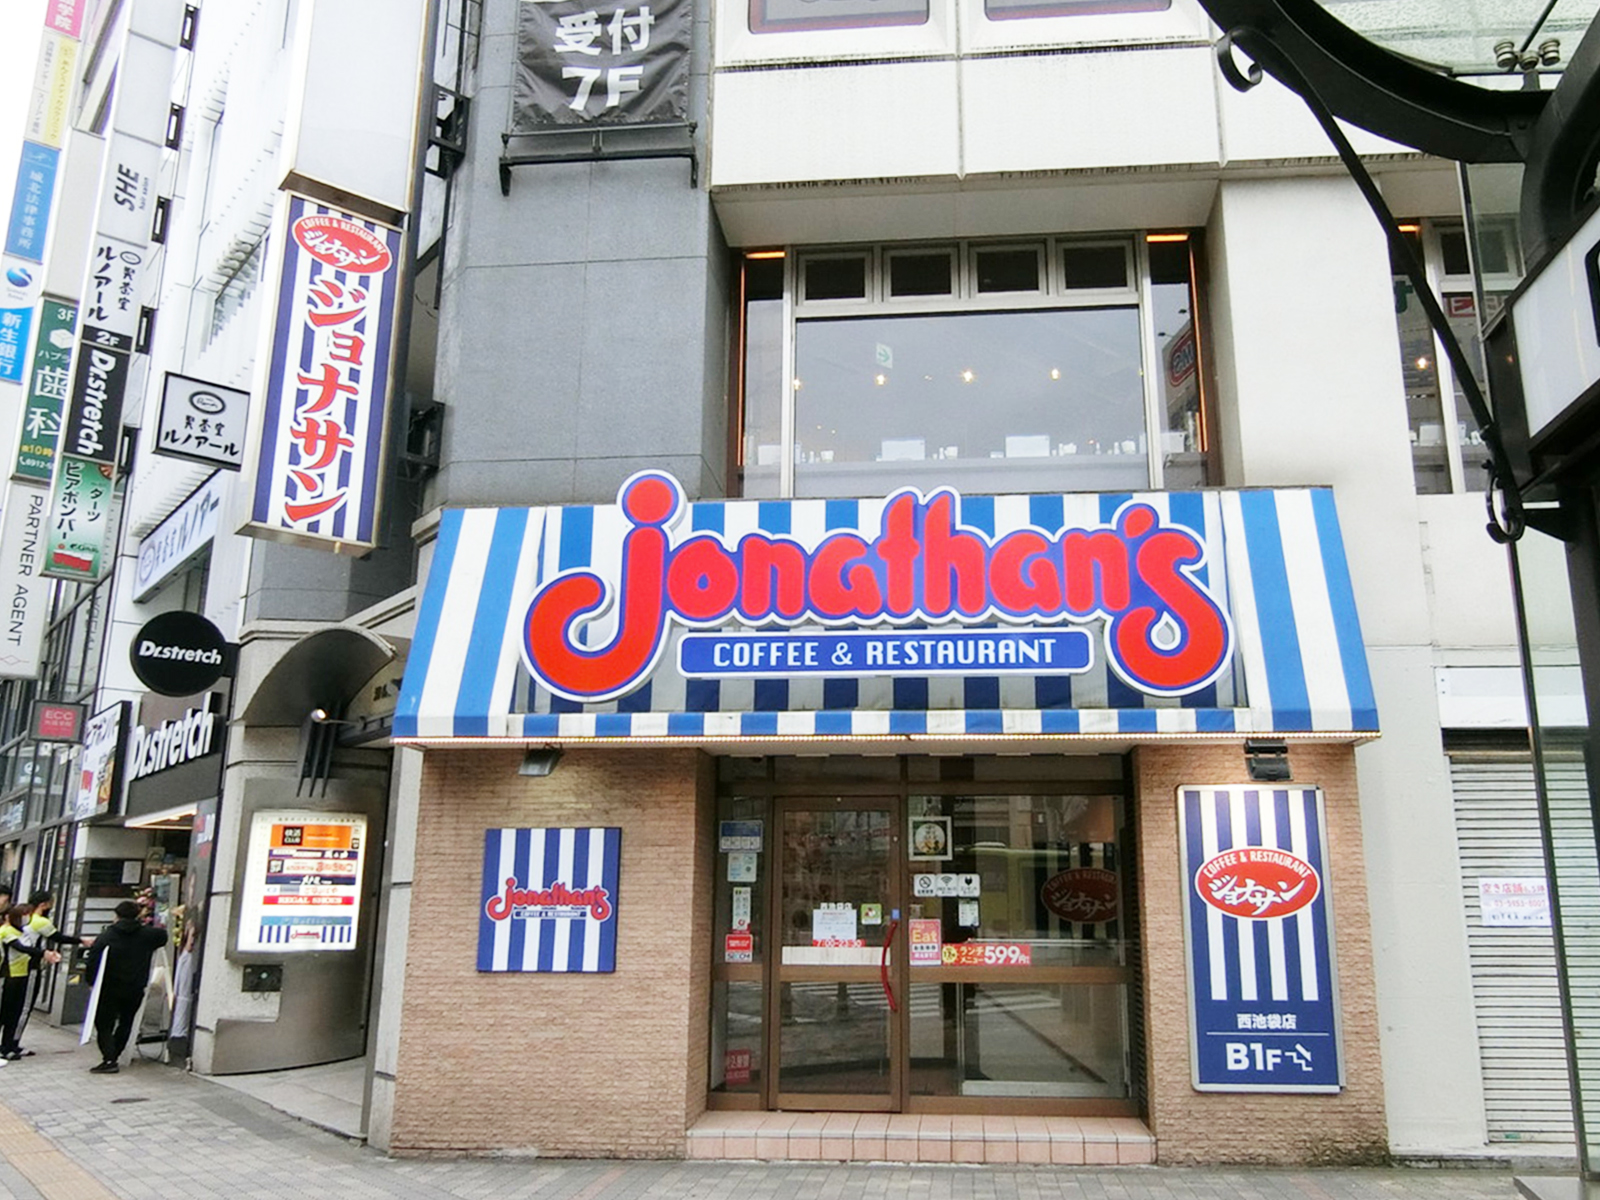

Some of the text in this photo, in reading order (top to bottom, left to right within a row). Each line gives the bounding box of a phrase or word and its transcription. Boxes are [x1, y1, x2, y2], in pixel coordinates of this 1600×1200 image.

[553, 6, 655, 55] 受付
[561, 65, 644, 111] 7F
[114, 163, 139, 212] SHE
[301, 217, 331, 230] COFFEE
[341, 221, 387, 255] RESTAURANT
[303, 230, 381, 267] ジョナサン
[87, 246, 117, 321] ルノアール
[57, 308, 75, 321] 3F
[0, 312, 22, 375] 新生銀行
[96, 330, 120, 347] 2F
[77, 350, 117, 456] Dr.stretch
[284, 278, 367, 523] ジョナサン
[163, 429, 240, 457] ルノアール
[6, 494, 43, 647] PARTNER AGENT
[523, 476, 1230, 696] jonathan's
[139, 640, 222, 665] Dr.stretch
[713, 638, 1056, 667] COFFEE & RESTAURANT
[45, 710, 74, 721] ECC
[1203, 850, 1312, 878] COFFEE & RESTAURANT
[487, 877, 610, 921] jonathan's
[1208, 874, 1306, 916] ジョナサン
[911, 929, 937, 943] Eat
[960, 946, 984, 955] ランチ
[960, 956, 984, 964] メニュー
[1236, 1013, 1297, 1030] 西池袋店
[1226, 1042, 1282, 1071] B1F
